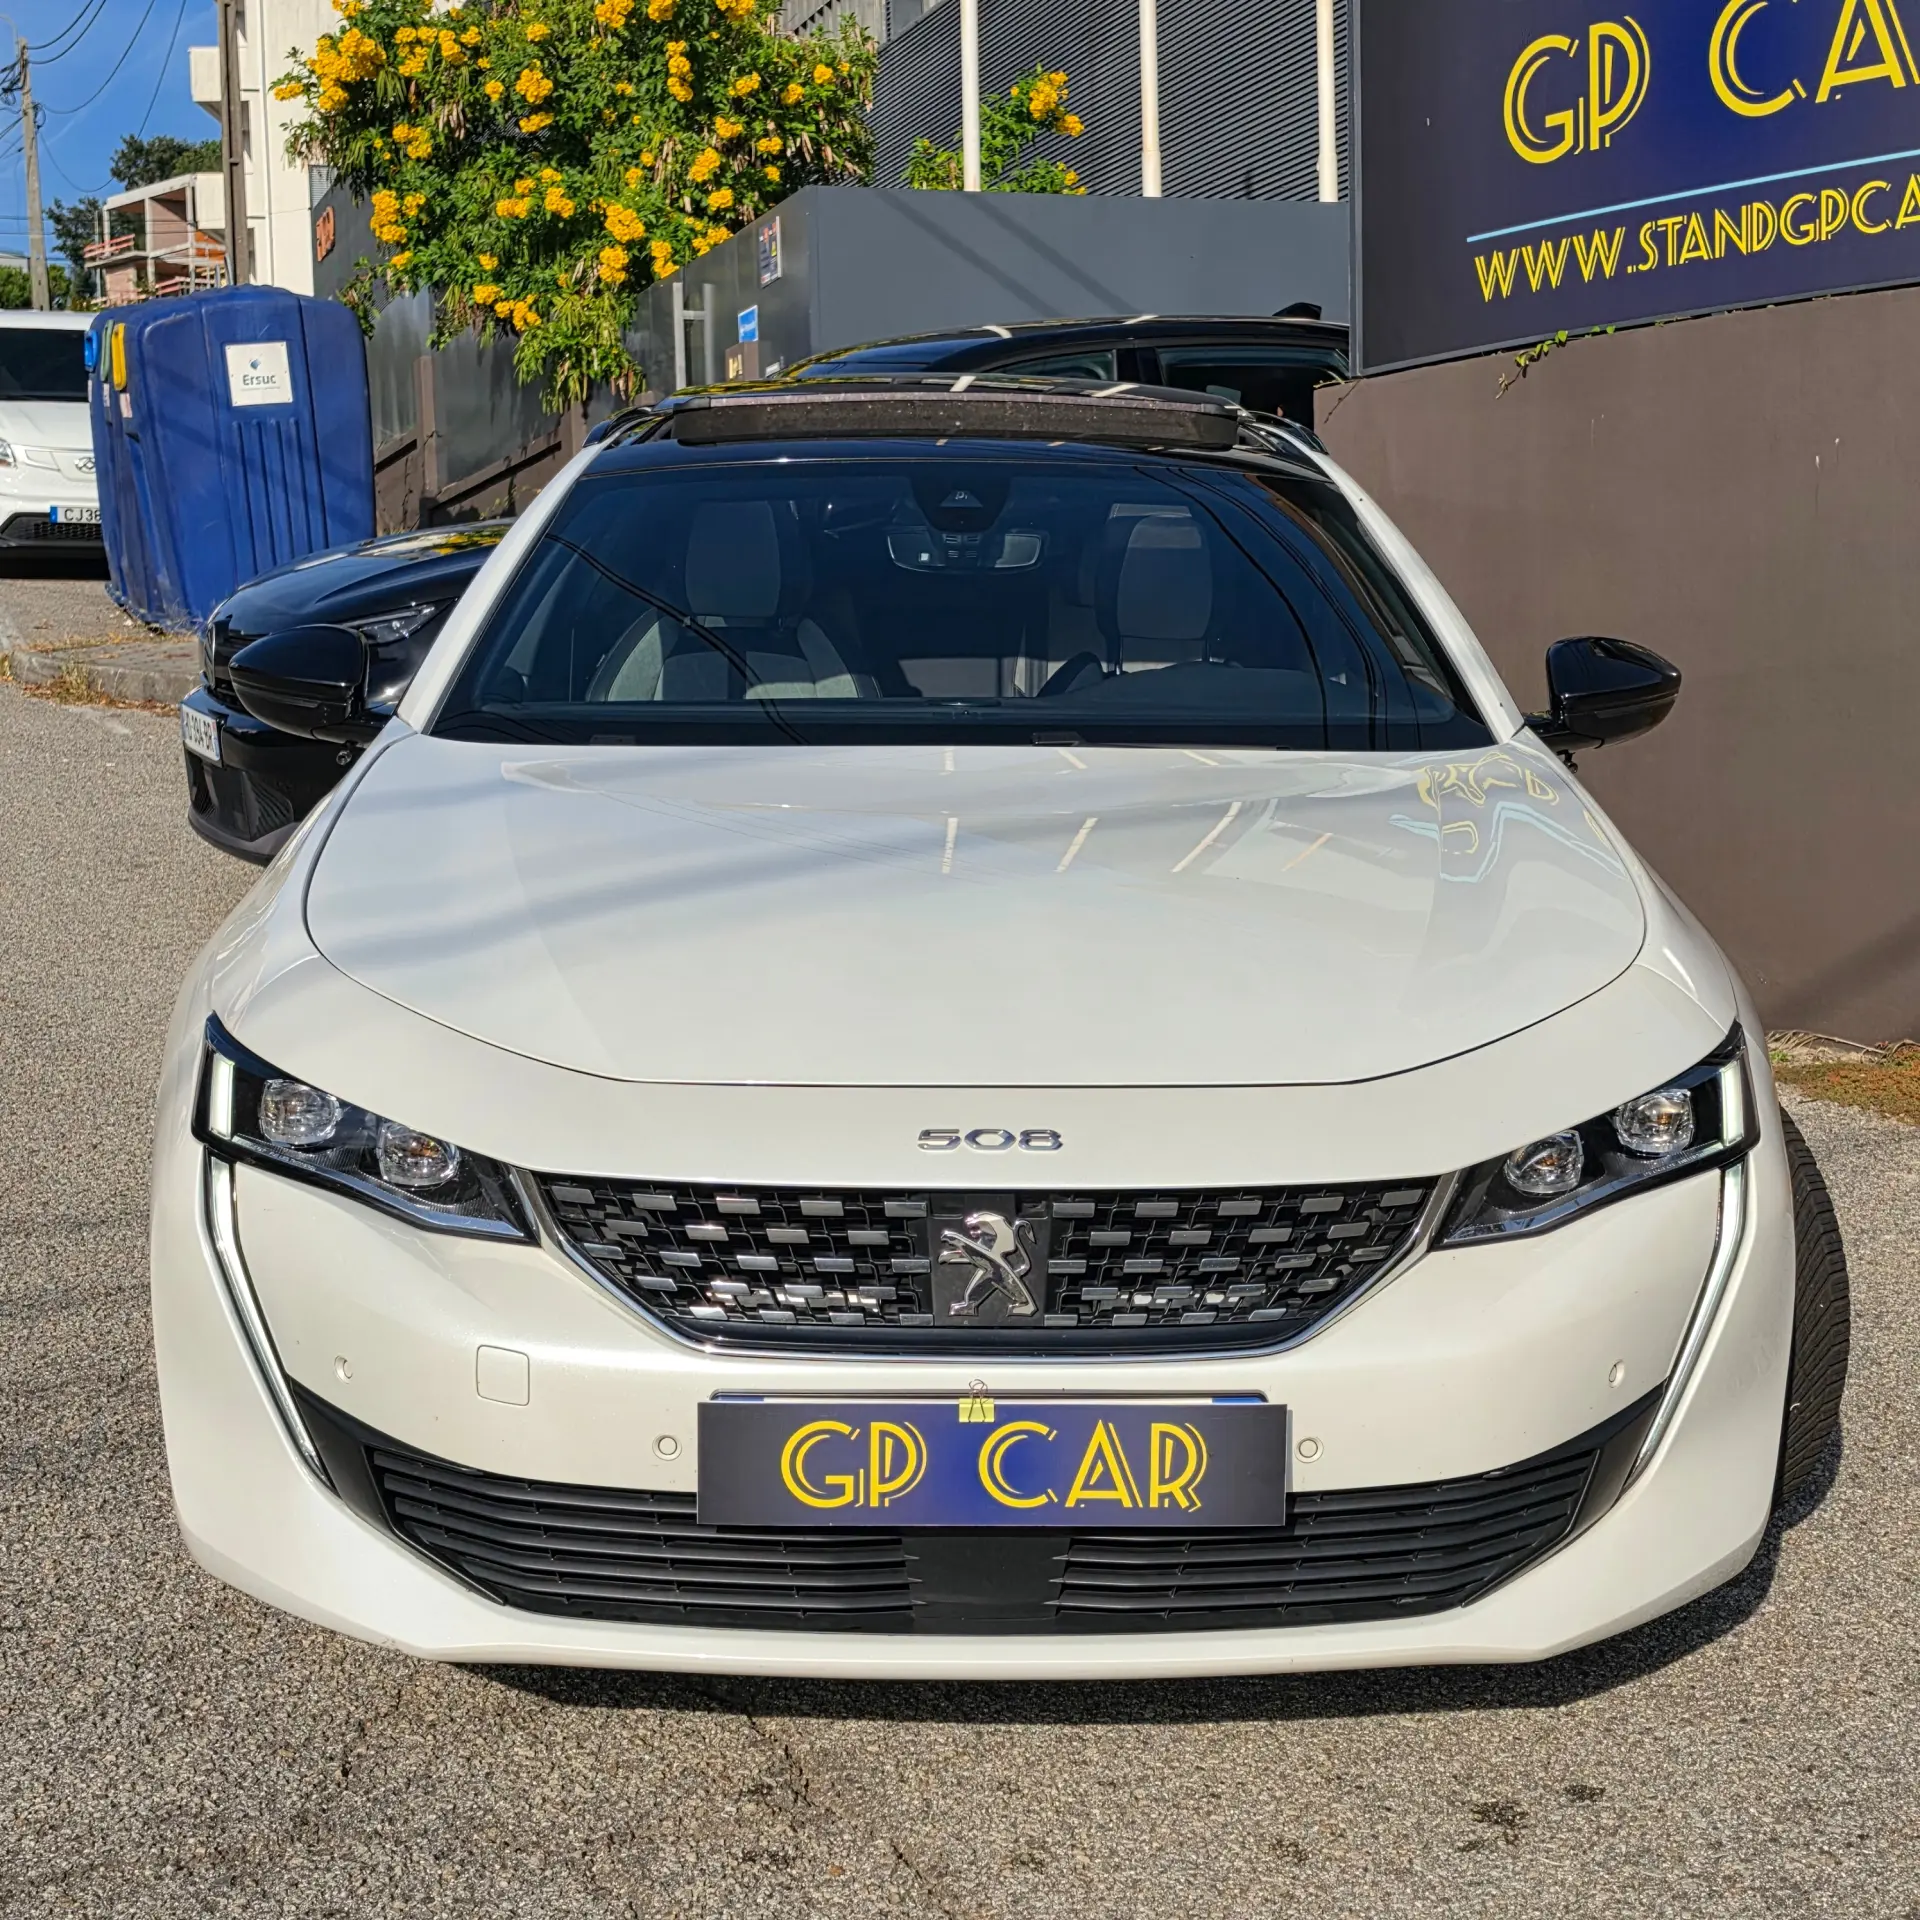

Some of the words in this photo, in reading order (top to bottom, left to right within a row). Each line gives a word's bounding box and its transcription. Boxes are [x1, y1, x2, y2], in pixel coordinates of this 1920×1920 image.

[1503, 15, 1651, 164] GP
[242, 374, 277, 386] Ersuc
[917, 1128, 1063, 1150] 508
[780, 1420, 927, 1508] GP
[978, 1420, 1208, 1512] CAR
